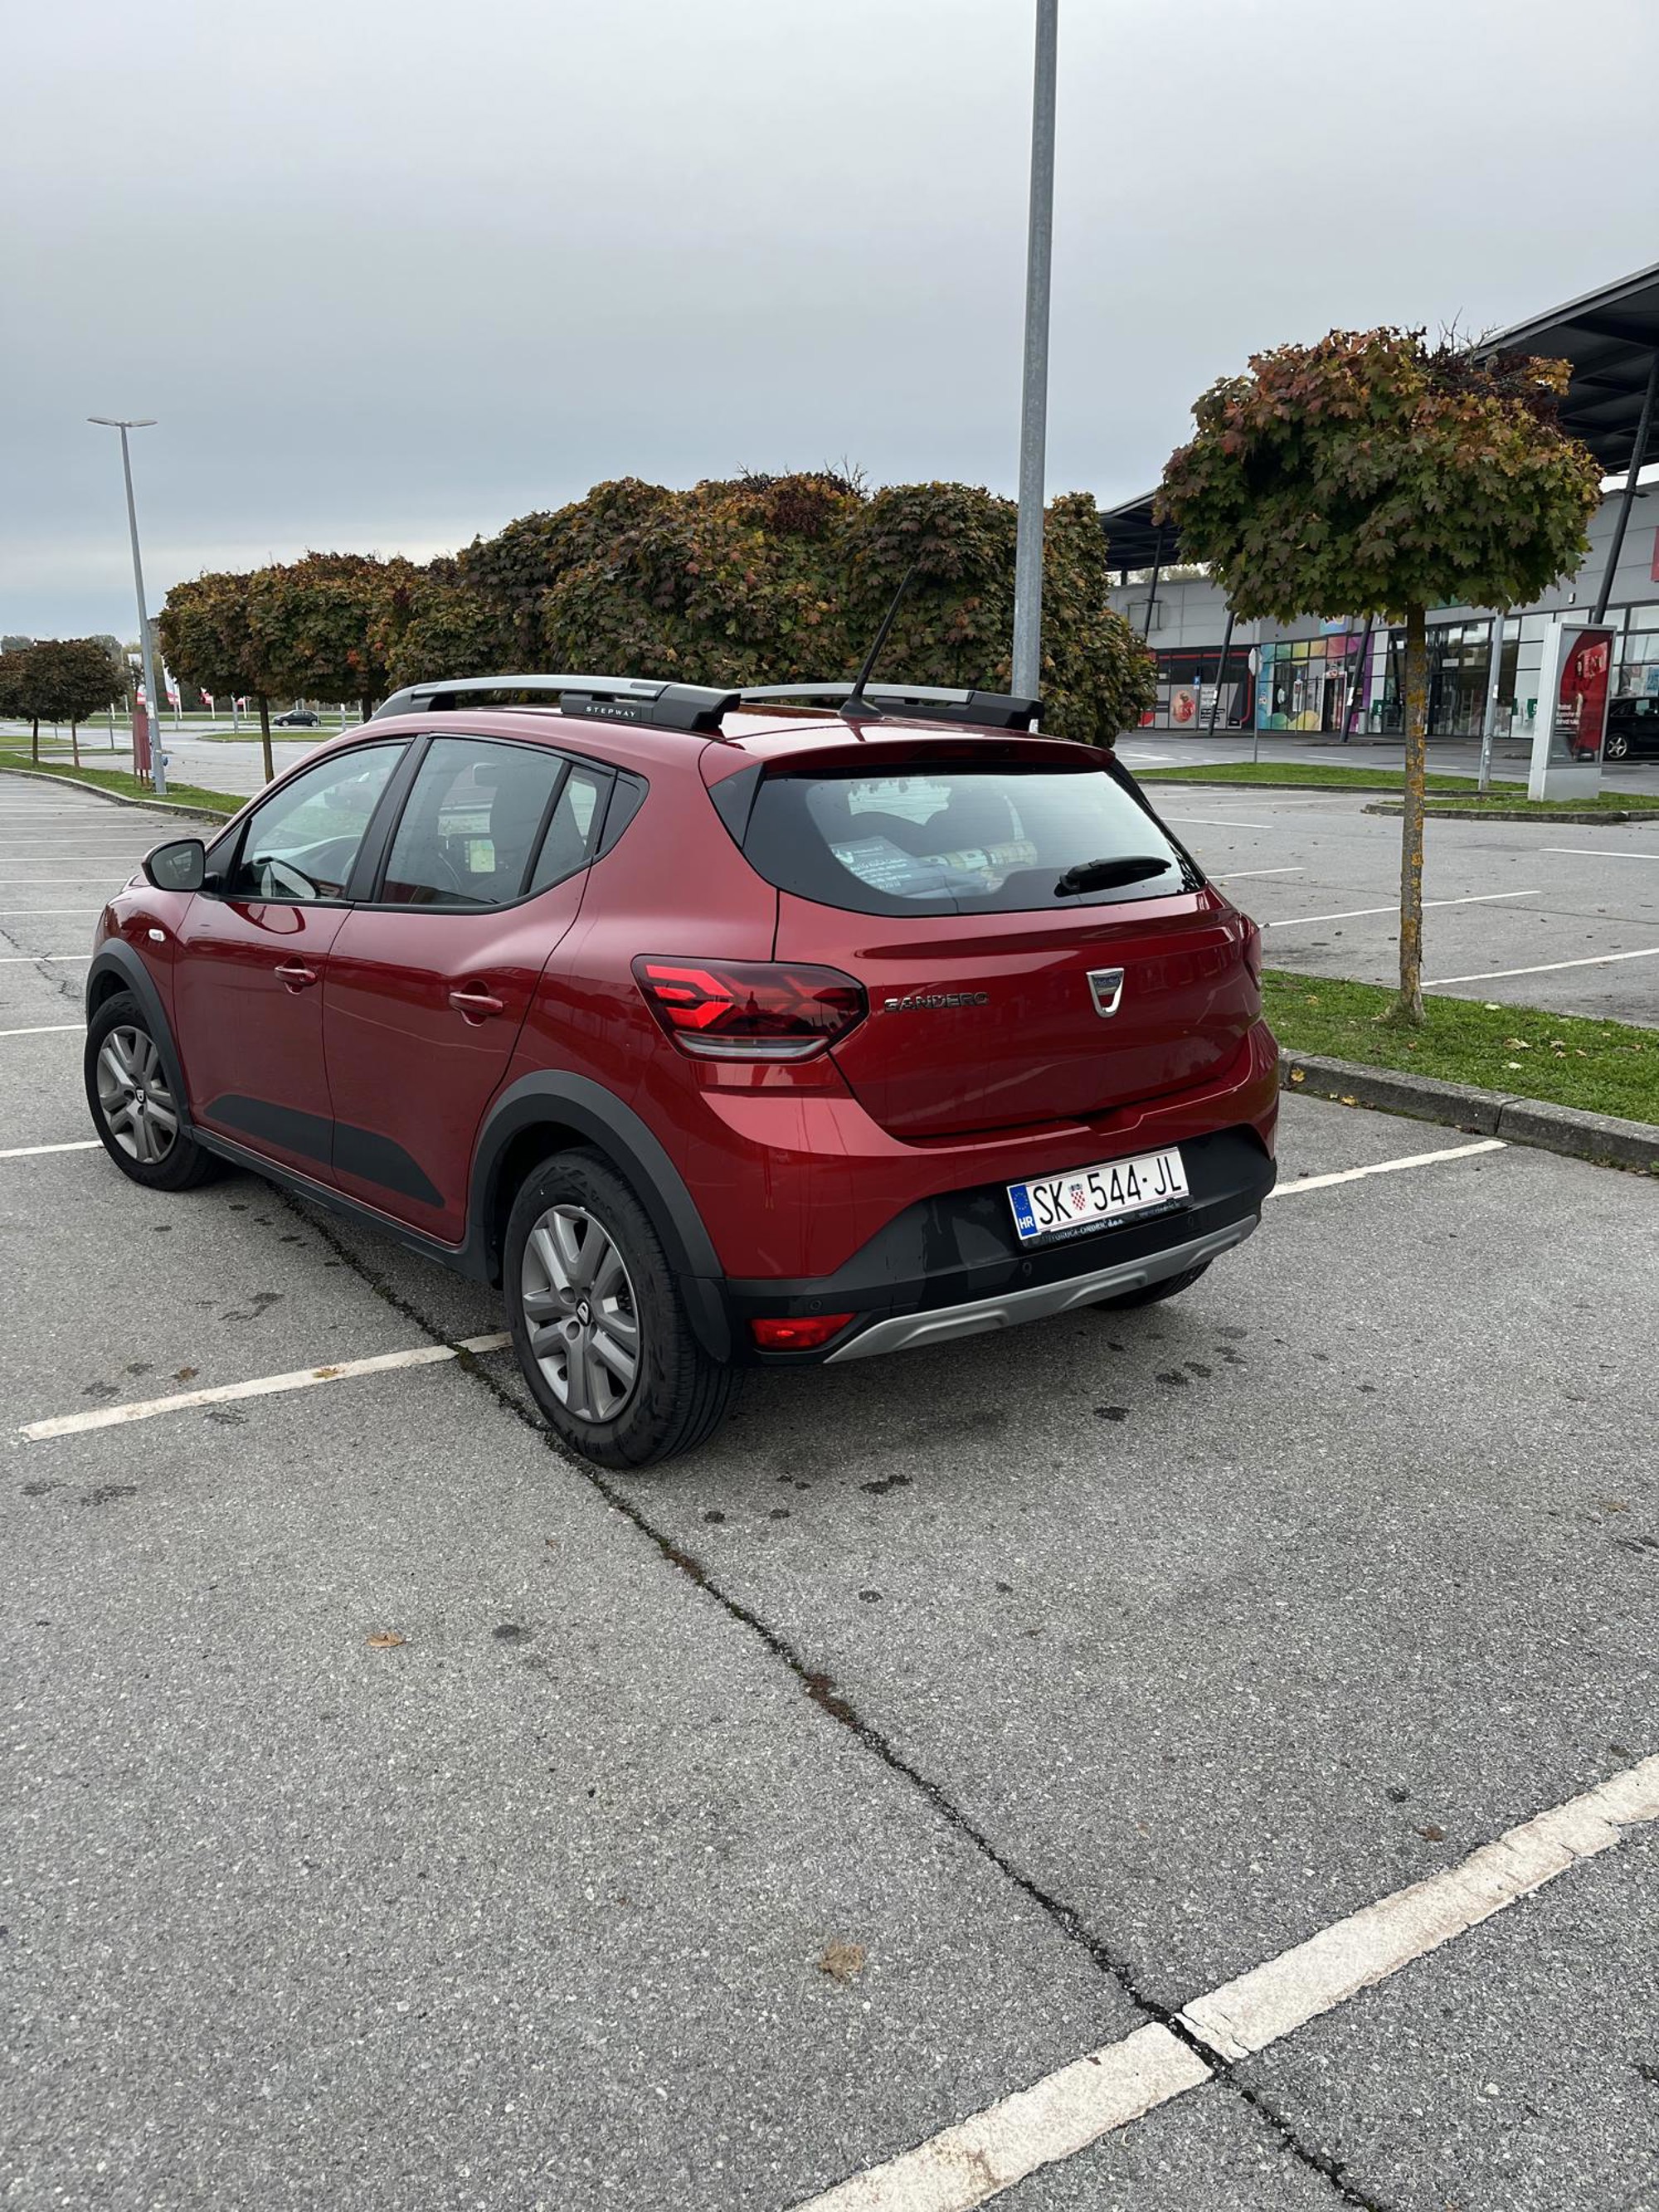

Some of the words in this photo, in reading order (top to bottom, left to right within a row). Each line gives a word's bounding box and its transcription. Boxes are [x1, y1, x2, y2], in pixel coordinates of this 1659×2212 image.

[586, 707, 636, 717] STEPWAY
[884, 992, 989, 1012] SANDERO
[1033, 1181, 1073, 1225] SK
[1019, 1216, 1035, 1229] HR
